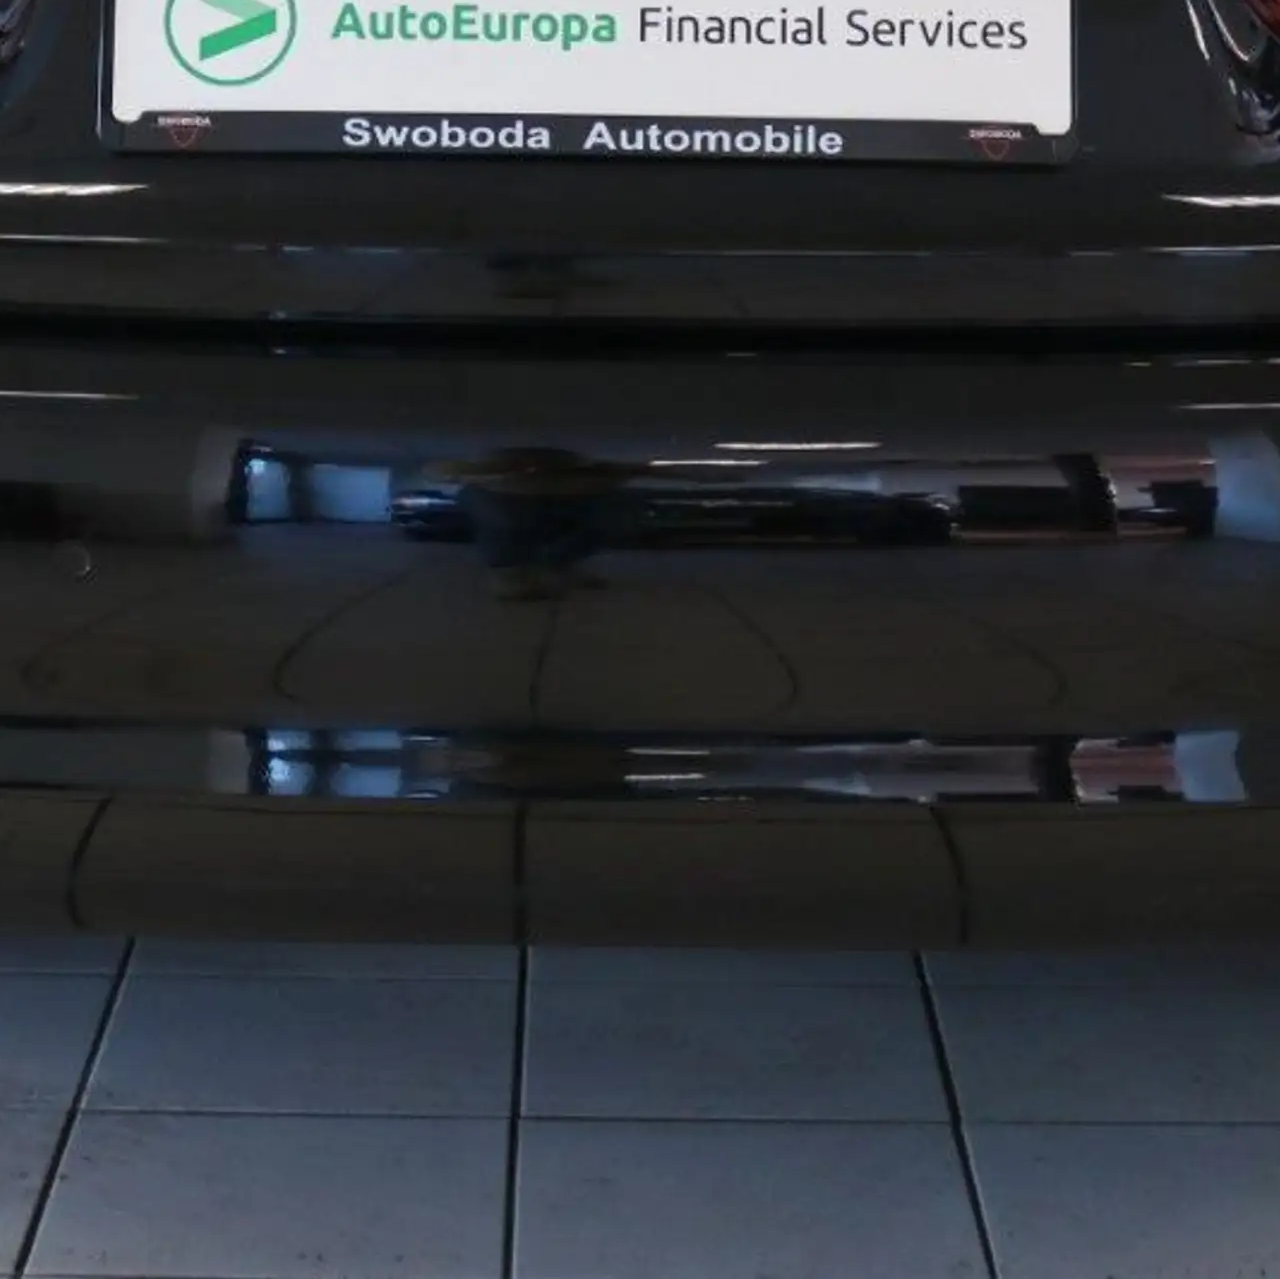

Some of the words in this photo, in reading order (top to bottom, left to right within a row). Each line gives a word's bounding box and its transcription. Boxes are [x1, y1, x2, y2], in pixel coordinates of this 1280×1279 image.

[331, 2, 617, 52] AutoEuropa
[639, 6, 827, 46] Financial
[846, 9, 1028, 50] Services
[342, 118, 552, 150] Swoboda
[583, 122, 844, 156] Automobile
